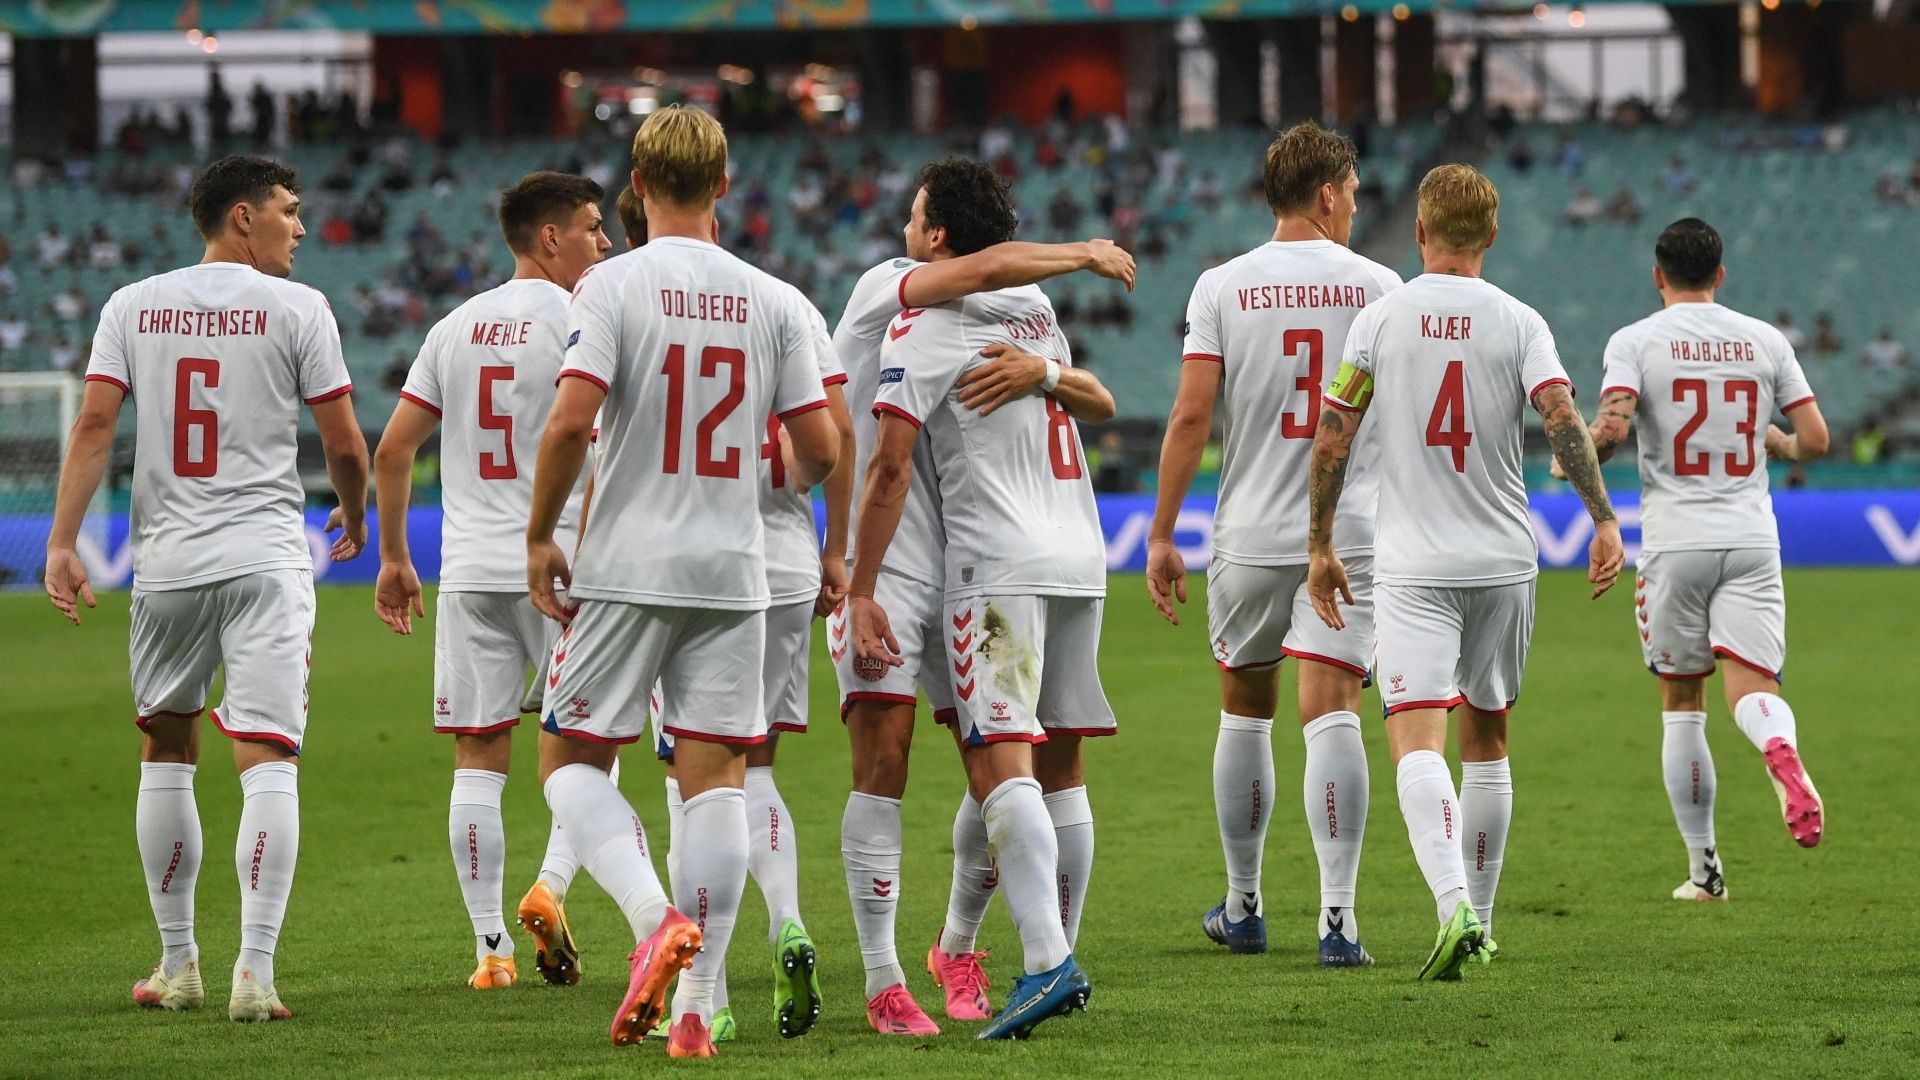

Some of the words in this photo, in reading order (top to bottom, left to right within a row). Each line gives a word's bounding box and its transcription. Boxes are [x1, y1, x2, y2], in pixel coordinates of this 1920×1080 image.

[138, 308, 268, 337] CHRISTENSEN
[660, 289, 747, 324] DOLBERG
[1238, 284, 1366, 311] VESTERGAARD
[471, 321, 532, 346] MÆHLE
[1421, 314, 1471, 340] KJÆR
[1670, 340, 1755, 362] HØJBJERG
[1281, 328, 1324, 439] 3
[173, 357, 220, 477] 6
[478, 365, 518, 480] 5
[661, 343, 746, 480] 12
[1045, 359, 1082, 480] 8
[1425, 360, 1473, 473] 4
[1672, 378, 1758, 477] 23
[768, 806, 780, 852] DANMARK
[1251, 779, 1261, 832] DANMARK
[1325, 781, 1339, 839] DANMARK
[1442, 798, 1454, 840] DANMARK
[250, 831, 267, 891] DANMARK
[469, 823, 480, 881] DANMARK
[631, 815, 648, 858] DANMARK
[1476, 831, 1488, 872] DANMARK
[161, 841, 184, 894] DANMARK
[697, 887, 707, 936] DANMA
[1061, 873, 1070, 930] DANMARK
